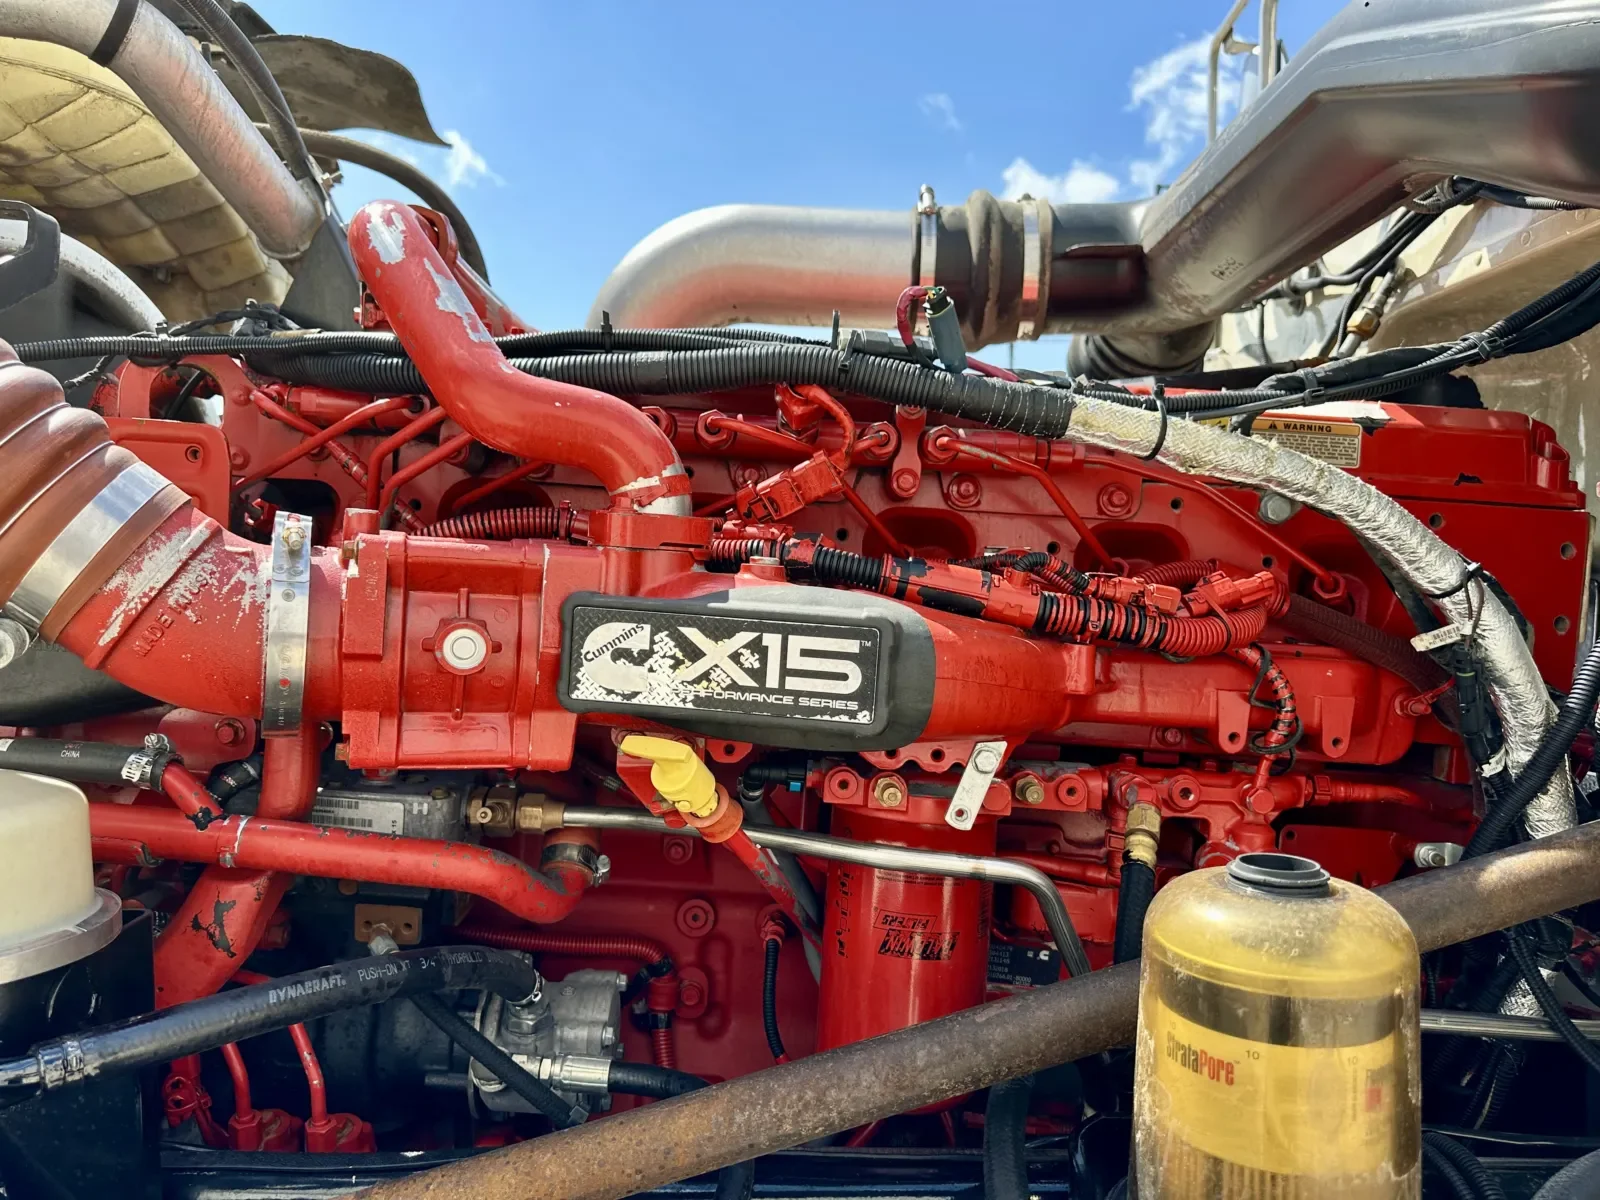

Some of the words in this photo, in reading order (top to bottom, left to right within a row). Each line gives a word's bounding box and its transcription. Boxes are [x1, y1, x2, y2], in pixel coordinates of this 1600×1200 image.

[1284, 422, 1332, 433] WARNING
[133, 613, 175, 657] MADE
[583, 622, 645, 662] Cummins
[798, 697, 859, 711] SERIES
[60, 749, 81, 759] CHINA
[268, 974, 344, 1004] DYNACRAFT
[357, 962, 398, 982] PUSH-ON
[1245, 1049, 1260, 1060] 10
